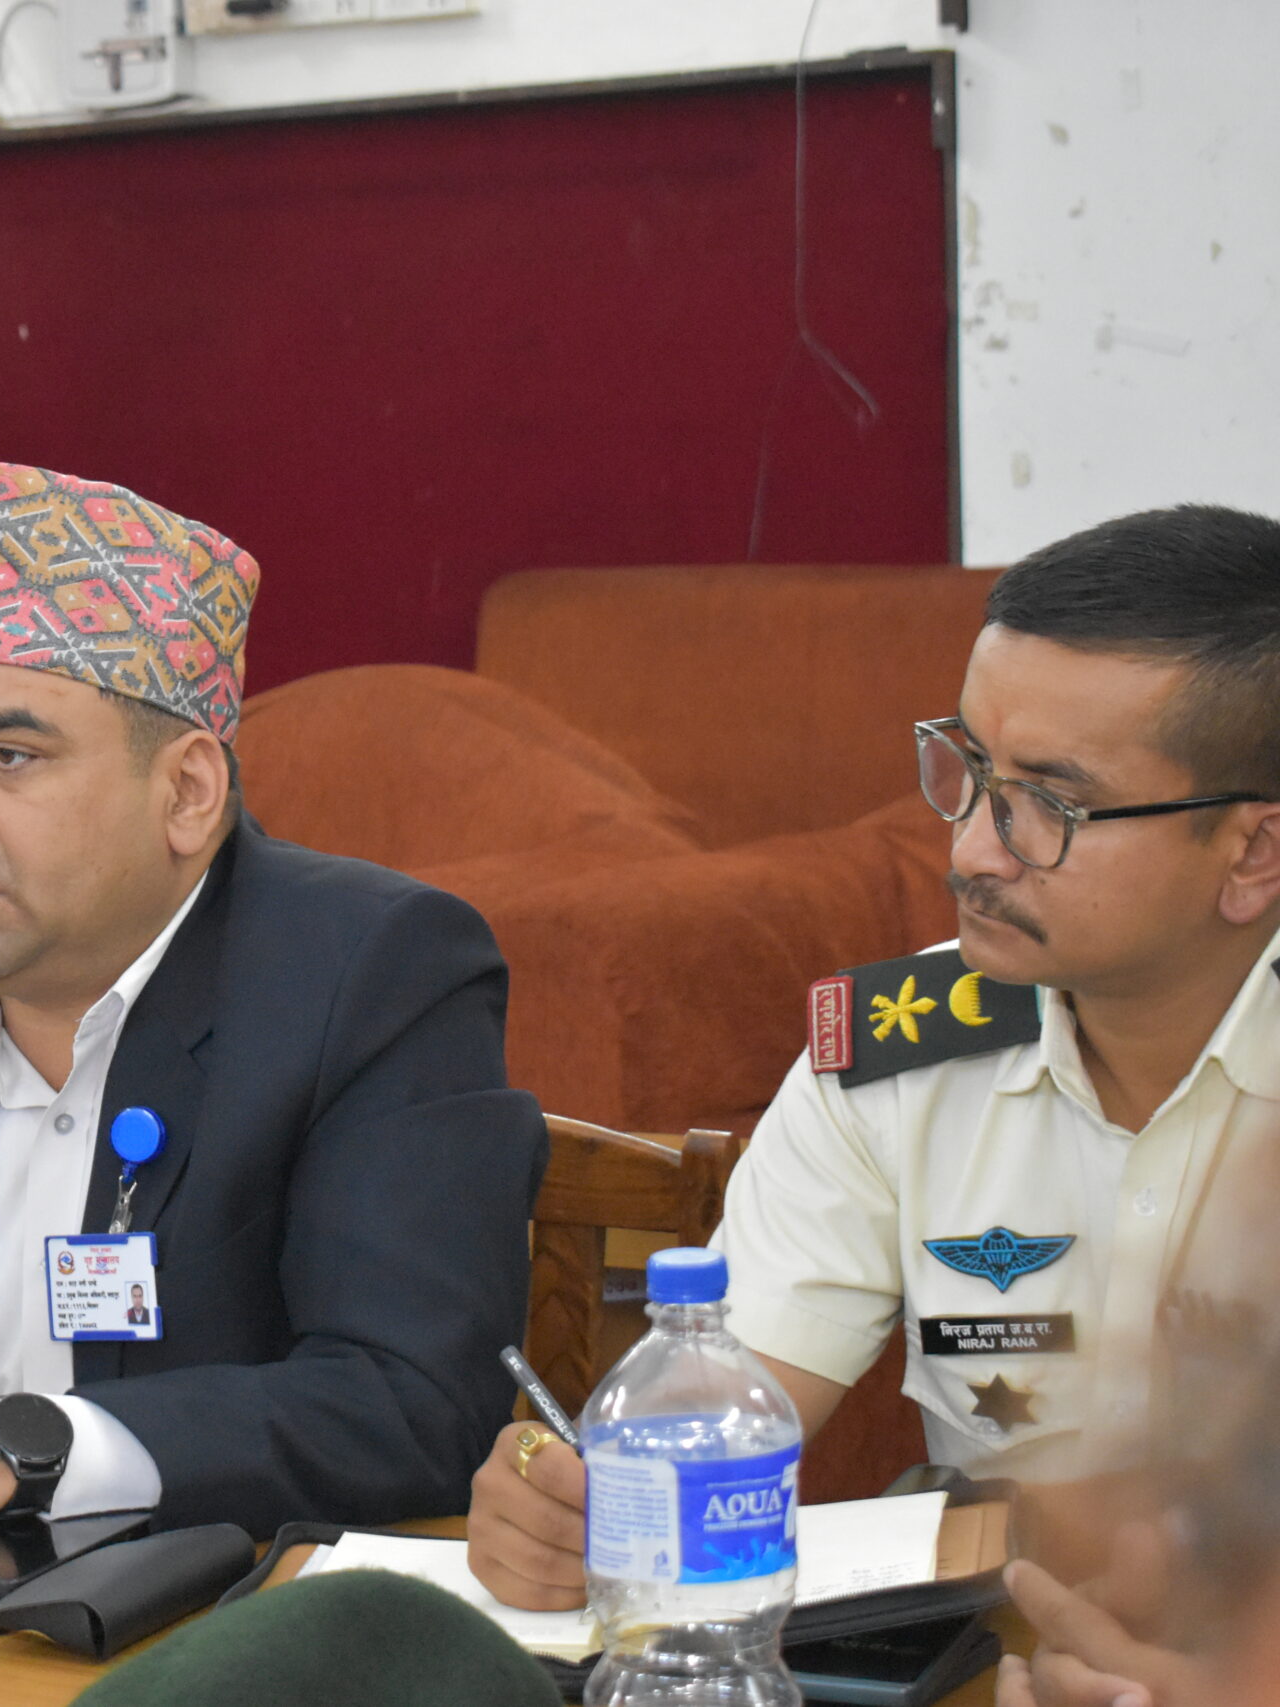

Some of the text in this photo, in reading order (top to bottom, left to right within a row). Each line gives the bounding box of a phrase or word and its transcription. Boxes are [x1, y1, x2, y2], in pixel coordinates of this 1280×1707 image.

[939, 1321, 972, 1337] निरज
[976, 1323, 1005, 1336] प्रताप
[957, 1337, 1038, 1350] NIRAJ RANA
[703, 1486, 783, 1521] AQUA
